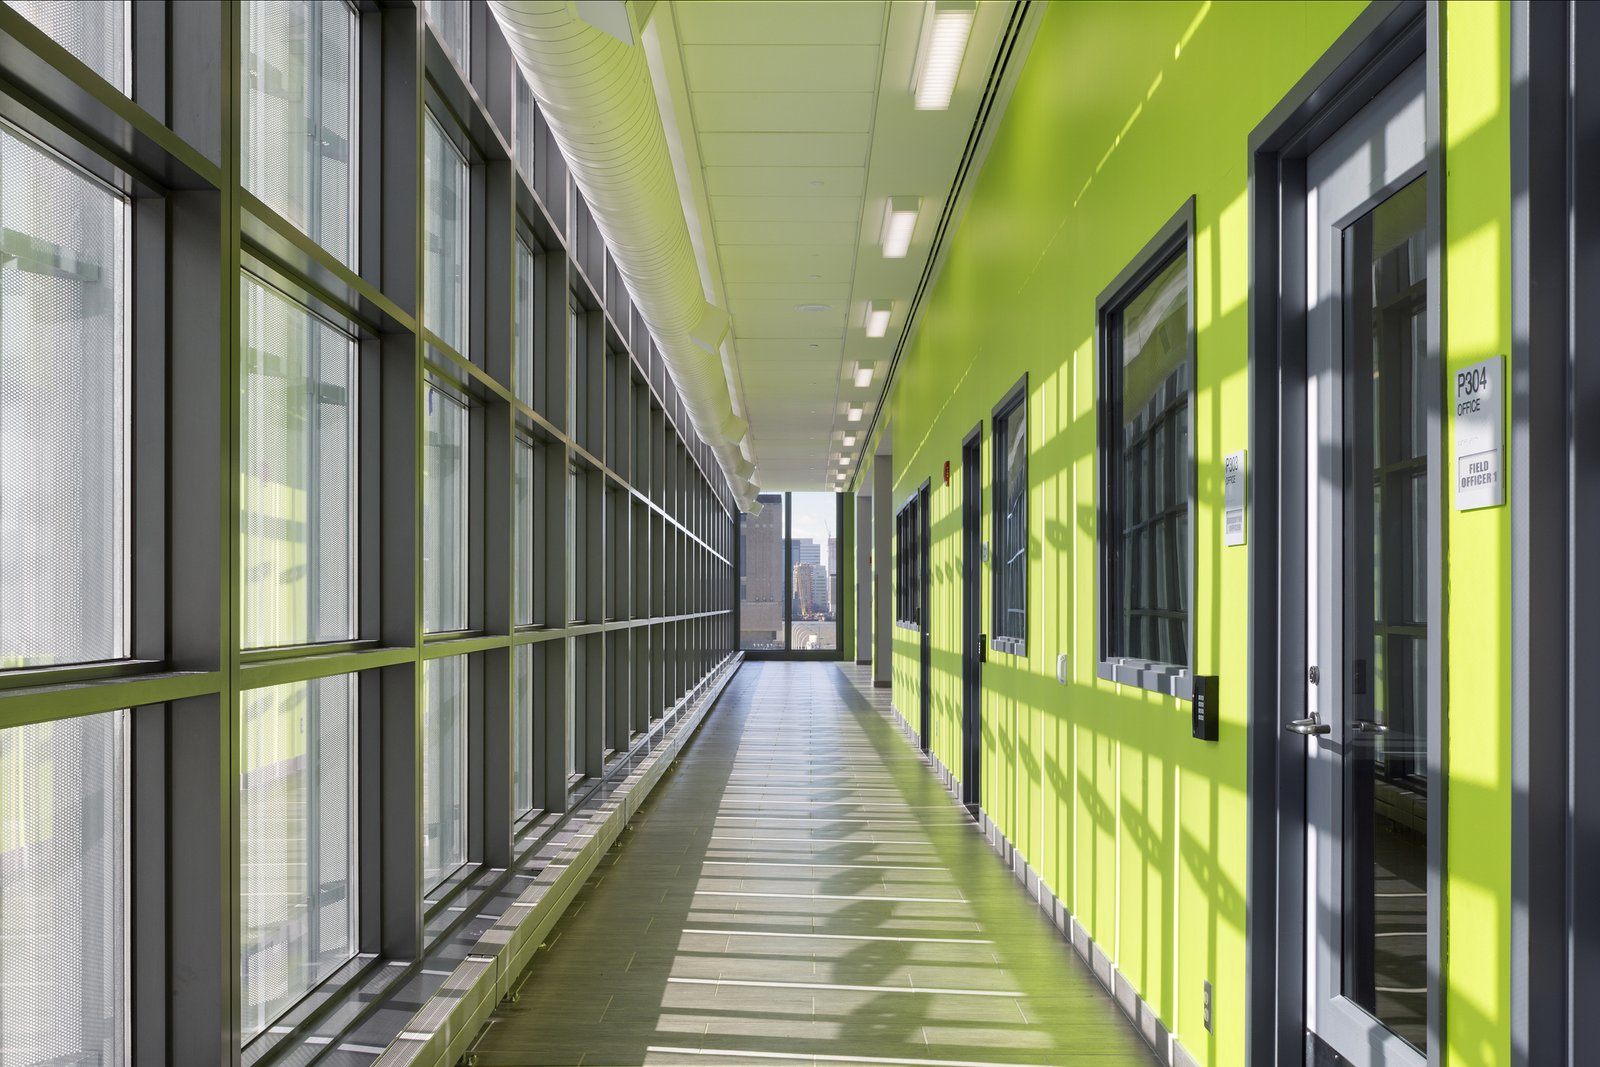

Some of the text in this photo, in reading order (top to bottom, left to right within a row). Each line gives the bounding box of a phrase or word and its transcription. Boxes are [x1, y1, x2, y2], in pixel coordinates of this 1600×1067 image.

[1458, 366, 1487, 397] P304
[1457, 398, 1480, 416] OFFICE
[1469, 461, 1489, 474] FIELD
[1461, 471, 1498, 488] OFFICER 1
